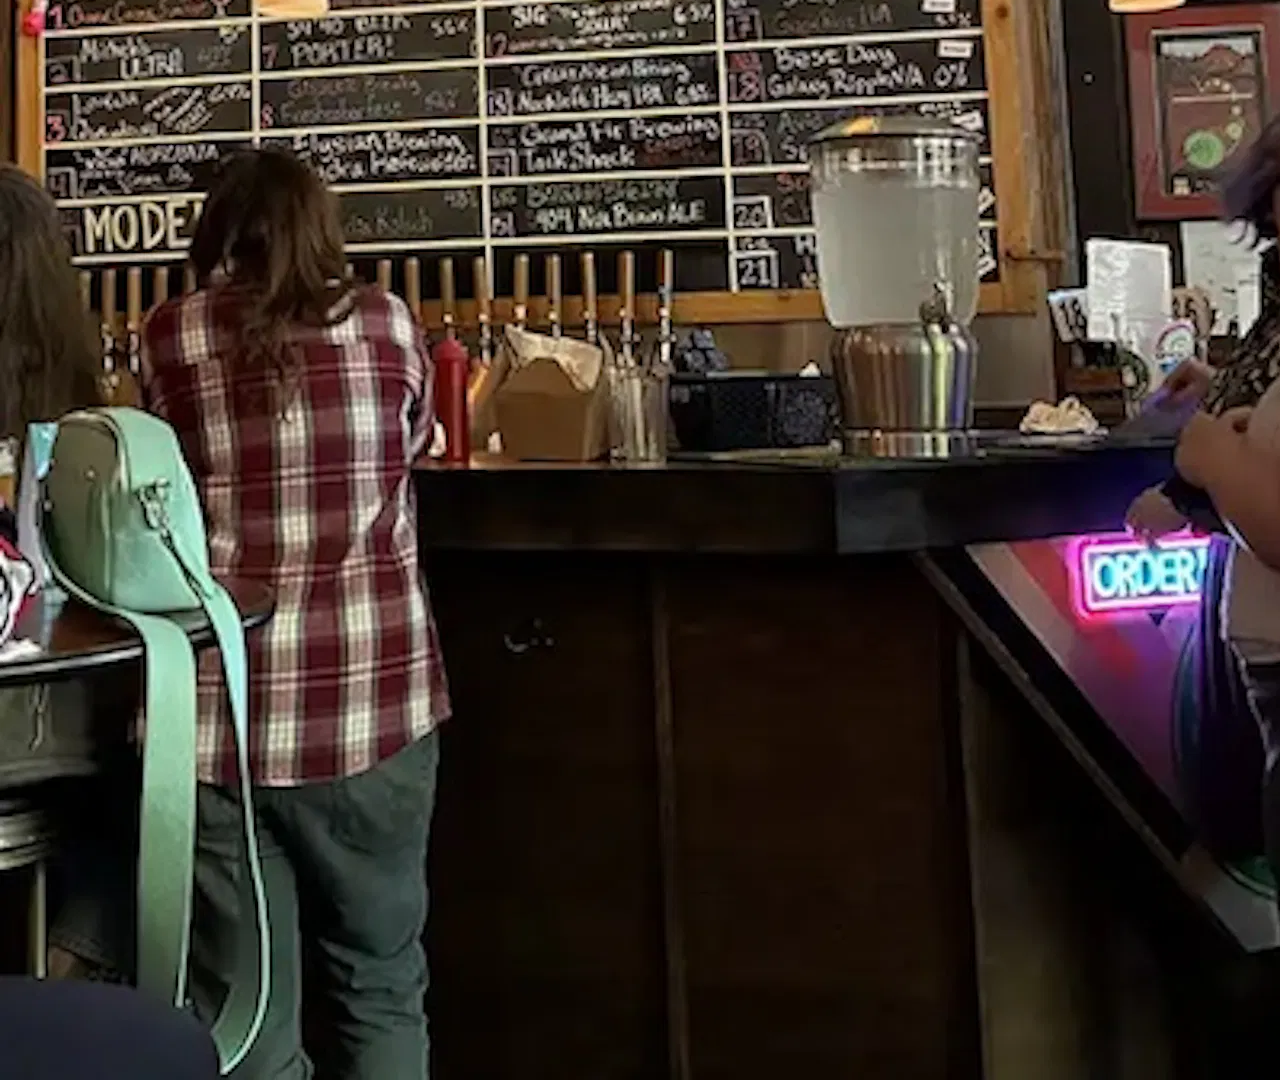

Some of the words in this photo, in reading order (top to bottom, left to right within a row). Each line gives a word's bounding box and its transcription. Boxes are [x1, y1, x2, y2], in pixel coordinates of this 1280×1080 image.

[83, 201, 204, 253] MODE
[738, 259, 770, 287] 21
[1091, 547, 1200, 597] ORDER
